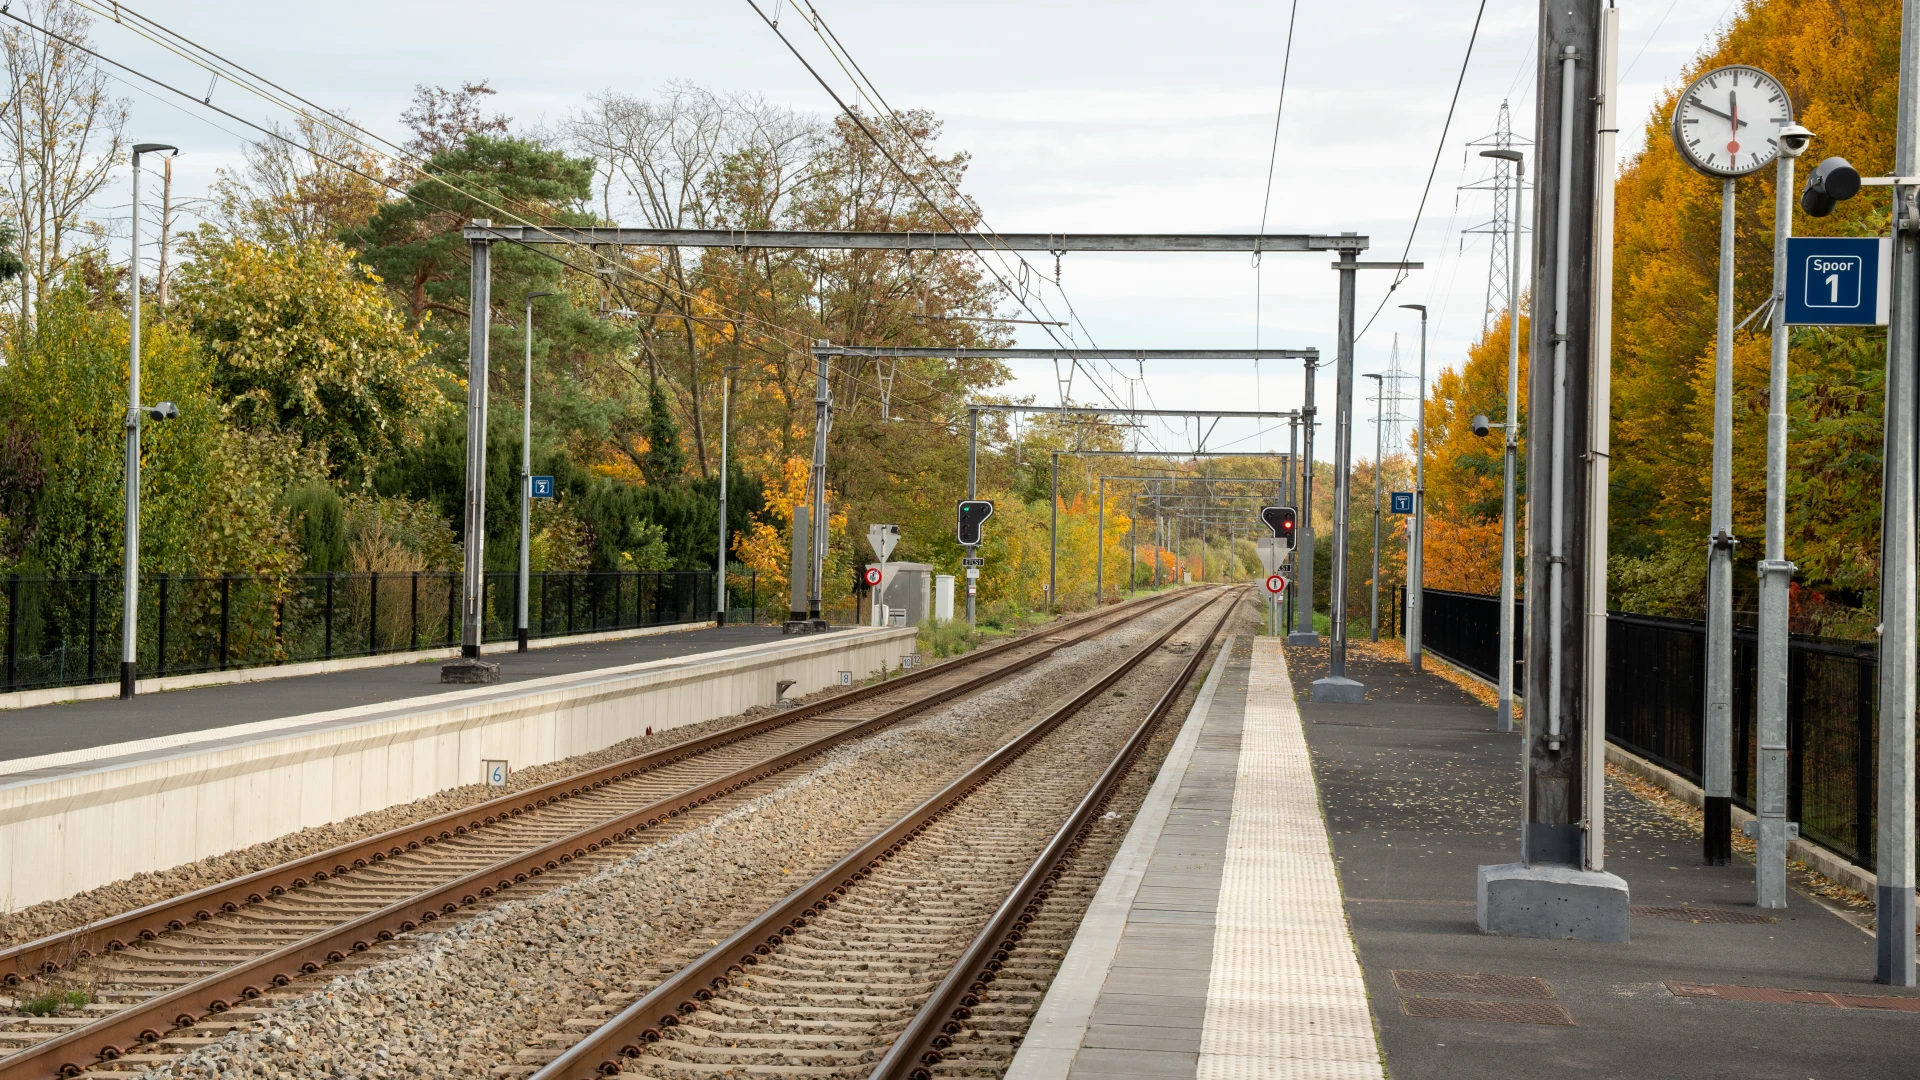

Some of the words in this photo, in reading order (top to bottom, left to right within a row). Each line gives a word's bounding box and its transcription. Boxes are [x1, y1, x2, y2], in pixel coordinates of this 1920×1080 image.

[1813, 259, 1854, 274] Spoor
[1825, 273, 1839, 303] 1
[540, 484, 545, 493] 2
[903, 658, 911, 667] 10
[913, 655, 921, 664] 12
[843, 674, 849, 684] 8
[492, 766, 502, 782] 6
